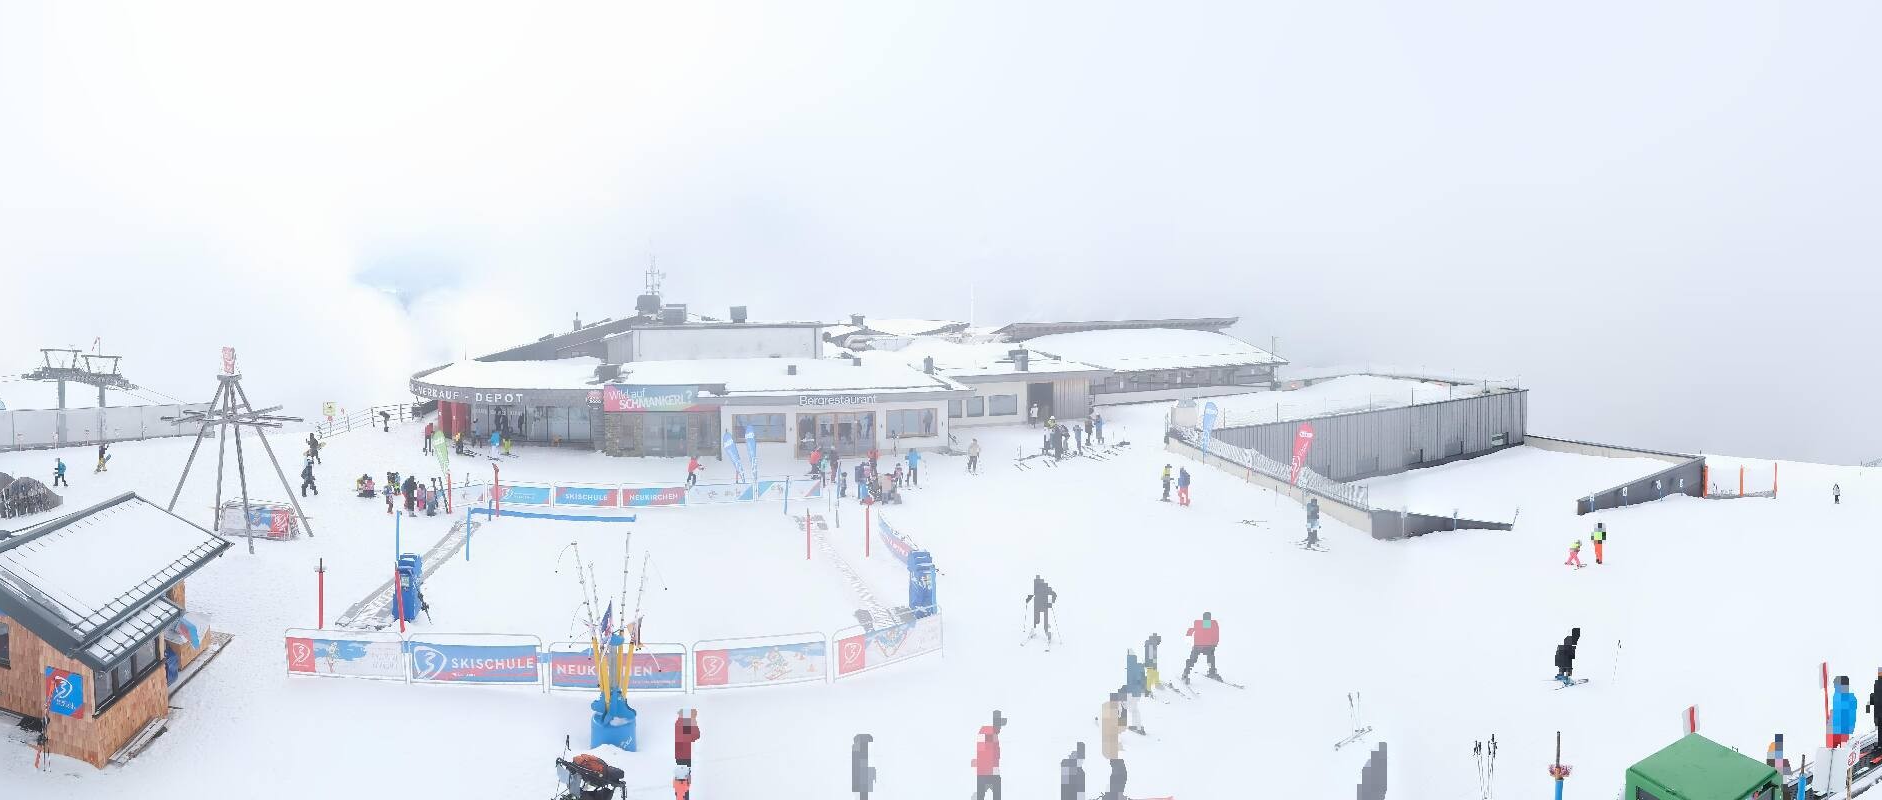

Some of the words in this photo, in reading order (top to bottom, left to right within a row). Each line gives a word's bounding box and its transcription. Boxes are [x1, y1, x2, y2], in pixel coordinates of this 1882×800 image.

[475, 392, 524, 403] DEPOT
[609, 389, 629, 400] Wild
[632, 387, 646, 398] auf
[799, 394, 877, 407] Bergrestaurant
[565, 493, 608, 501] SKISCHULE
[629, 493, 678, 501] NEUKIRCHEN
[451, 657, 535, 670] SKISCHULE
[556, 663, 653, 676] NEUKHEN
